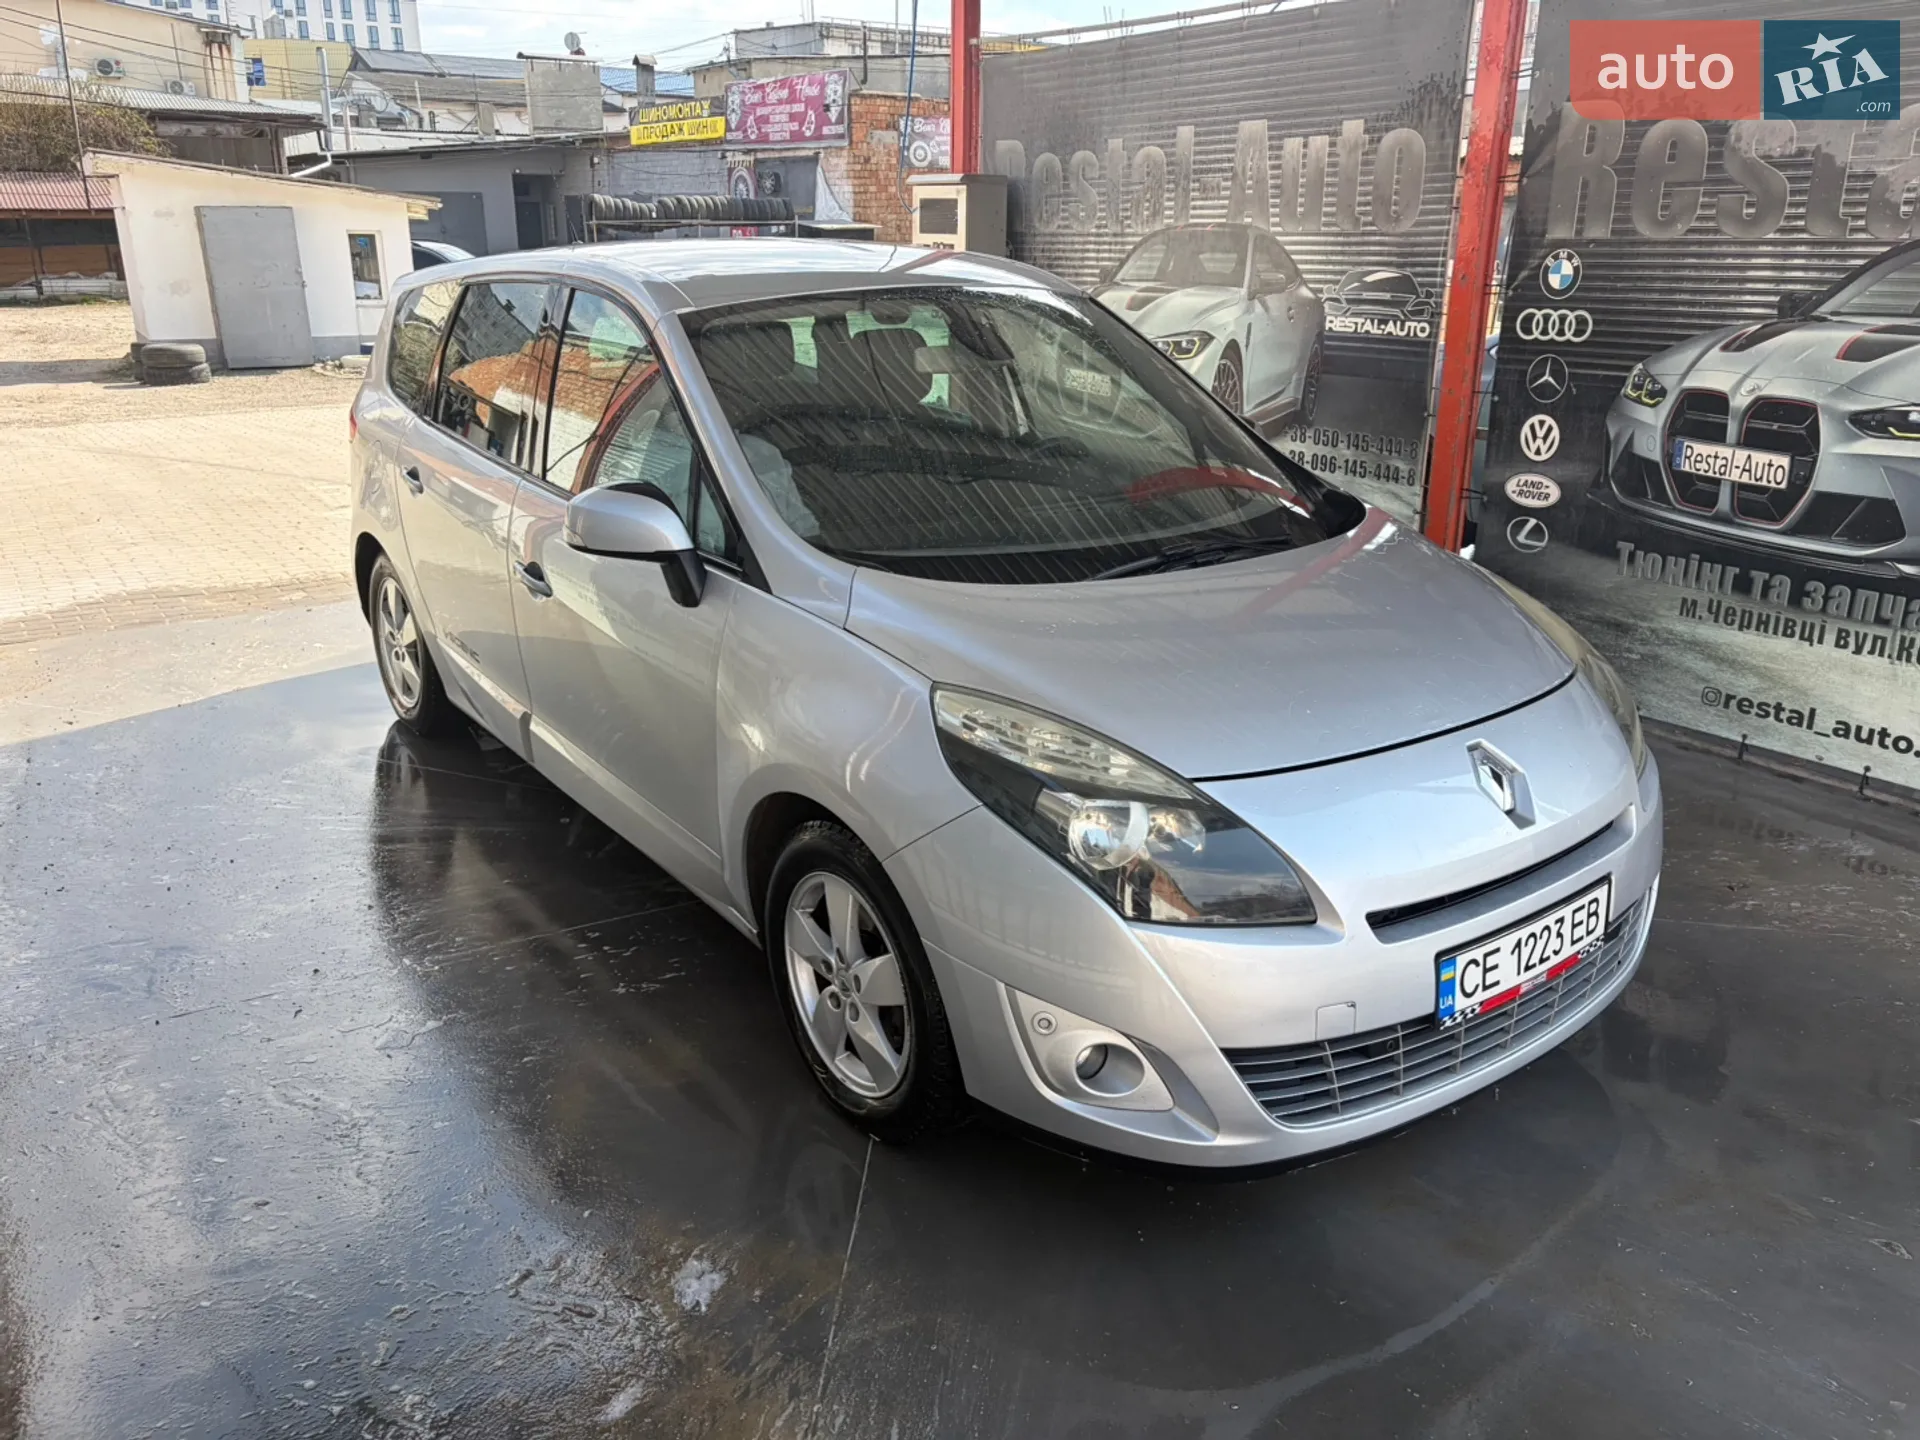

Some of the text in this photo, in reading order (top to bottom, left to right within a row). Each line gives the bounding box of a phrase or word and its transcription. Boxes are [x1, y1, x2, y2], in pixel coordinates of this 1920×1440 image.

[642, 122, 685, 140] ПРОДАЖ
[1546, 251, 1579, 267] BMW
[1682, 444, 1786, 486] Restal-Auto
[1616, 540, 1740, 596] Тюнінг
[1750, 570, 1792, 608] та
[1460, 947, 1501, 999] CE
[1511, 915, 1565, 977] 1223
[1570, 897, 1600, 946] EB
[1440, 994, 1454, 1010] UA
